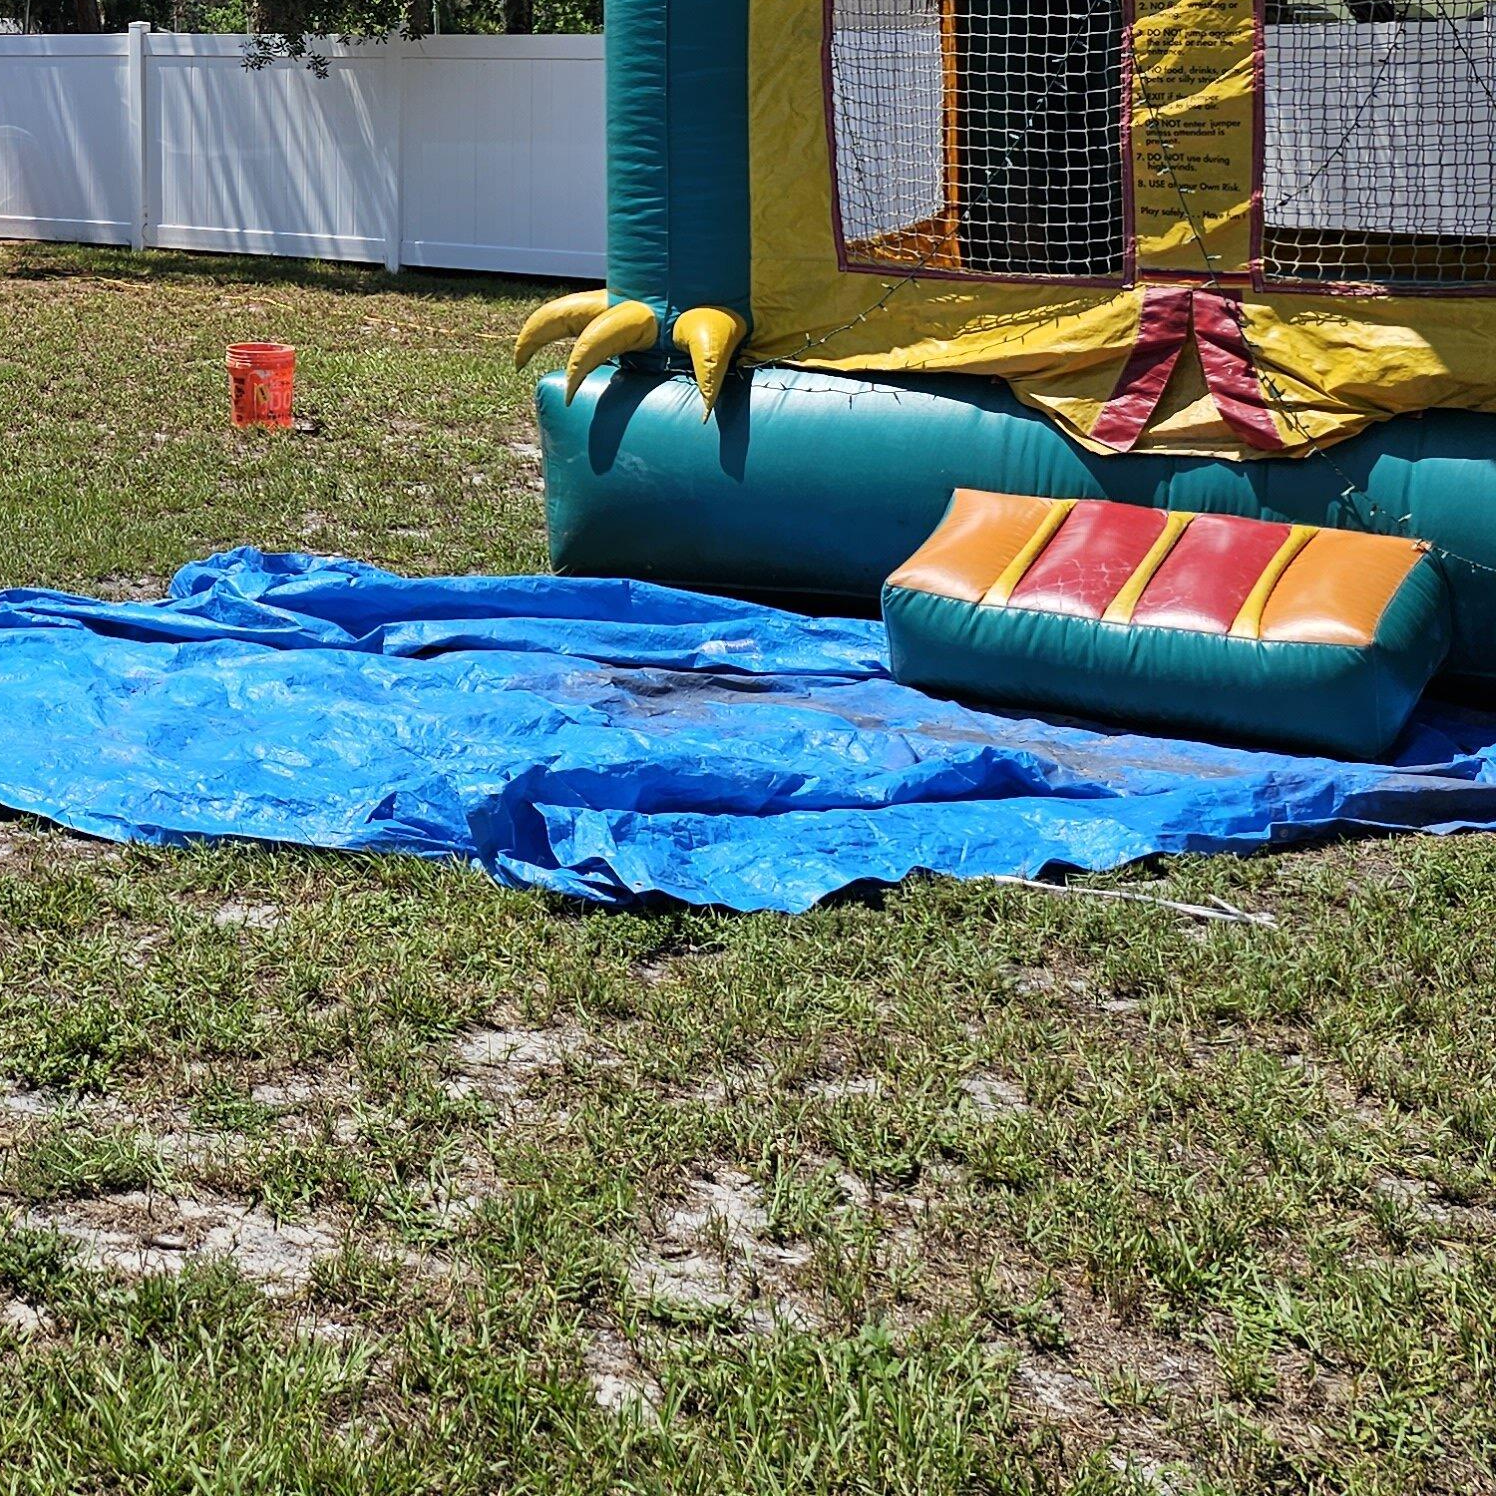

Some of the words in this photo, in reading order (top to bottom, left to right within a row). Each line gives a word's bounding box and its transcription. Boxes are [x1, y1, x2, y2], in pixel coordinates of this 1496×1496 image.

[1150, 2, 1165, 10] NO
[1163, 28, 1183, 36] NOT
[1146, 92, 1165, 100] EXIT
[1167, 92, 1173, 100] if
[1161, 119, 1181, 127] NOT
[1210, 119, 1240, 129] jumper
[1136, 152, 1145, 161] 7.
[1147, 153, 1161, 161] DO
[1164, 153, 1184, 161] NOT
[1203, 154, 1230, 166] during
[1137, 179, 1146, 188] 8.
[1149, 180, 1165, 188] USE
[1200, 182, 1220, 191] Own
[1222, 183, 1241, 192] Risk.
[1140, 206, 1159, 217] Play
